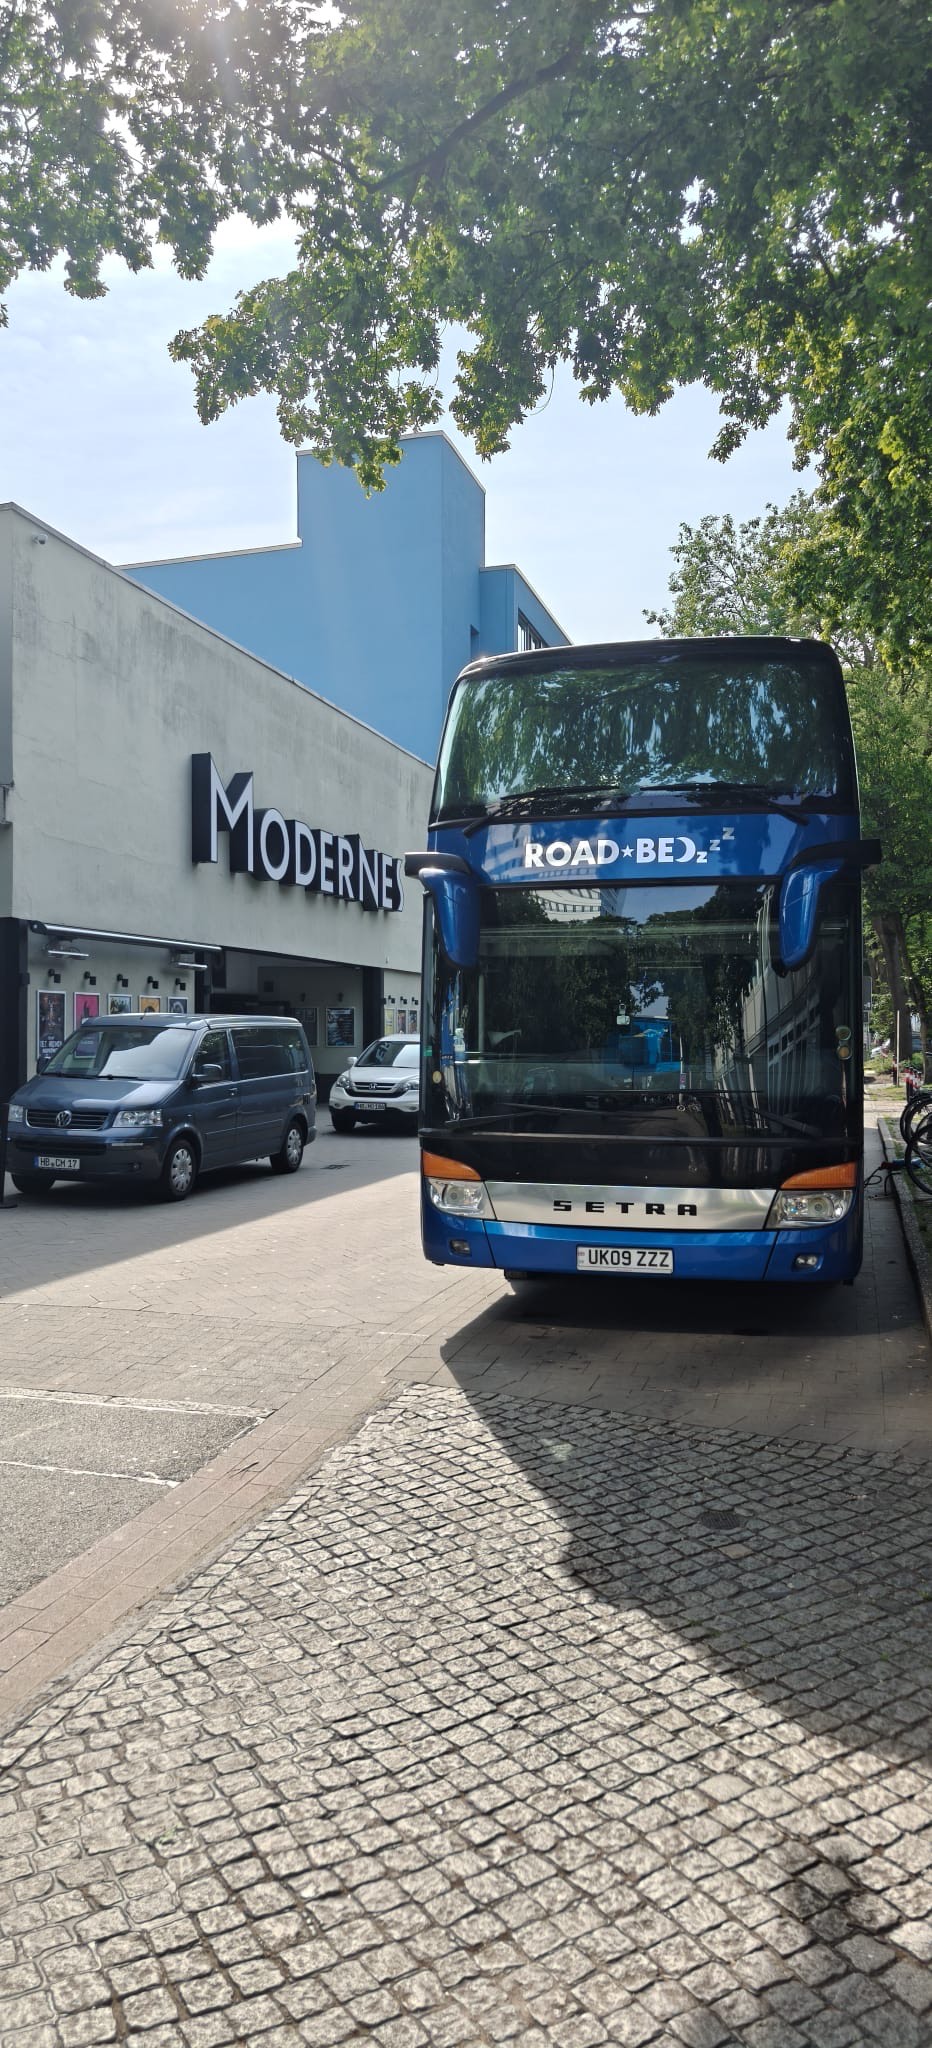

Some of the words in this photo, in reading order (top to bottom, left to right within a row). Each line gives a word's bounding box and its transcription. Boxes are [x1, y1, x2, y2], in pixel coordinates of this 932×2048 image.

[210, 755, 405, 912] MODERNES
[524, 839, 620, 869] ROAD
[40, 1157, 50, 1166] HB
[68, 1159, 77, 1168] 17
[553, 1200, 698, 1216] SETRA
[588, 1249, 632, 1266] UK09
[636, 1251, 670, 1267] ZZZ
